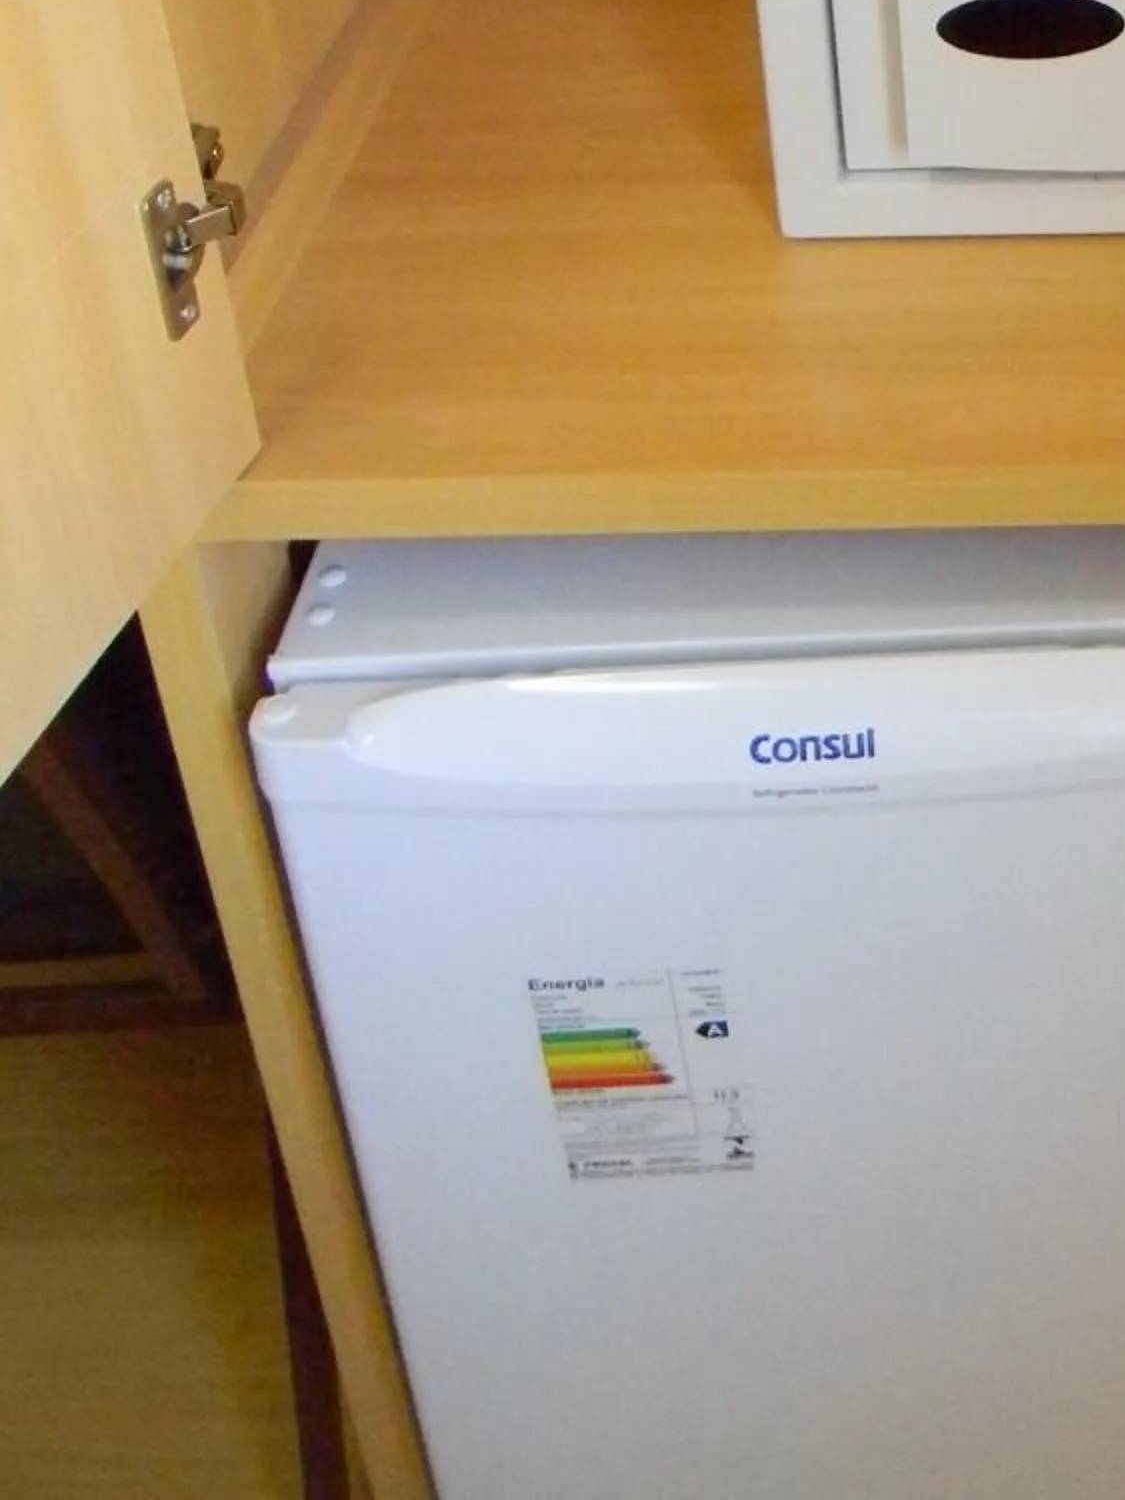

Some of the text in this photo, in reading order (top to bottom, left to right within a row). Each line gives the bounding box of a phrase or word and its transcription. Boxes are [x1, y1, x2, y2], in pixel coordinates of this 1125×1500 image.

[750, 727, 876, 764] Consul
[528, 977, 605, 992] Energia
[707, 1022, 722, 1038] A
